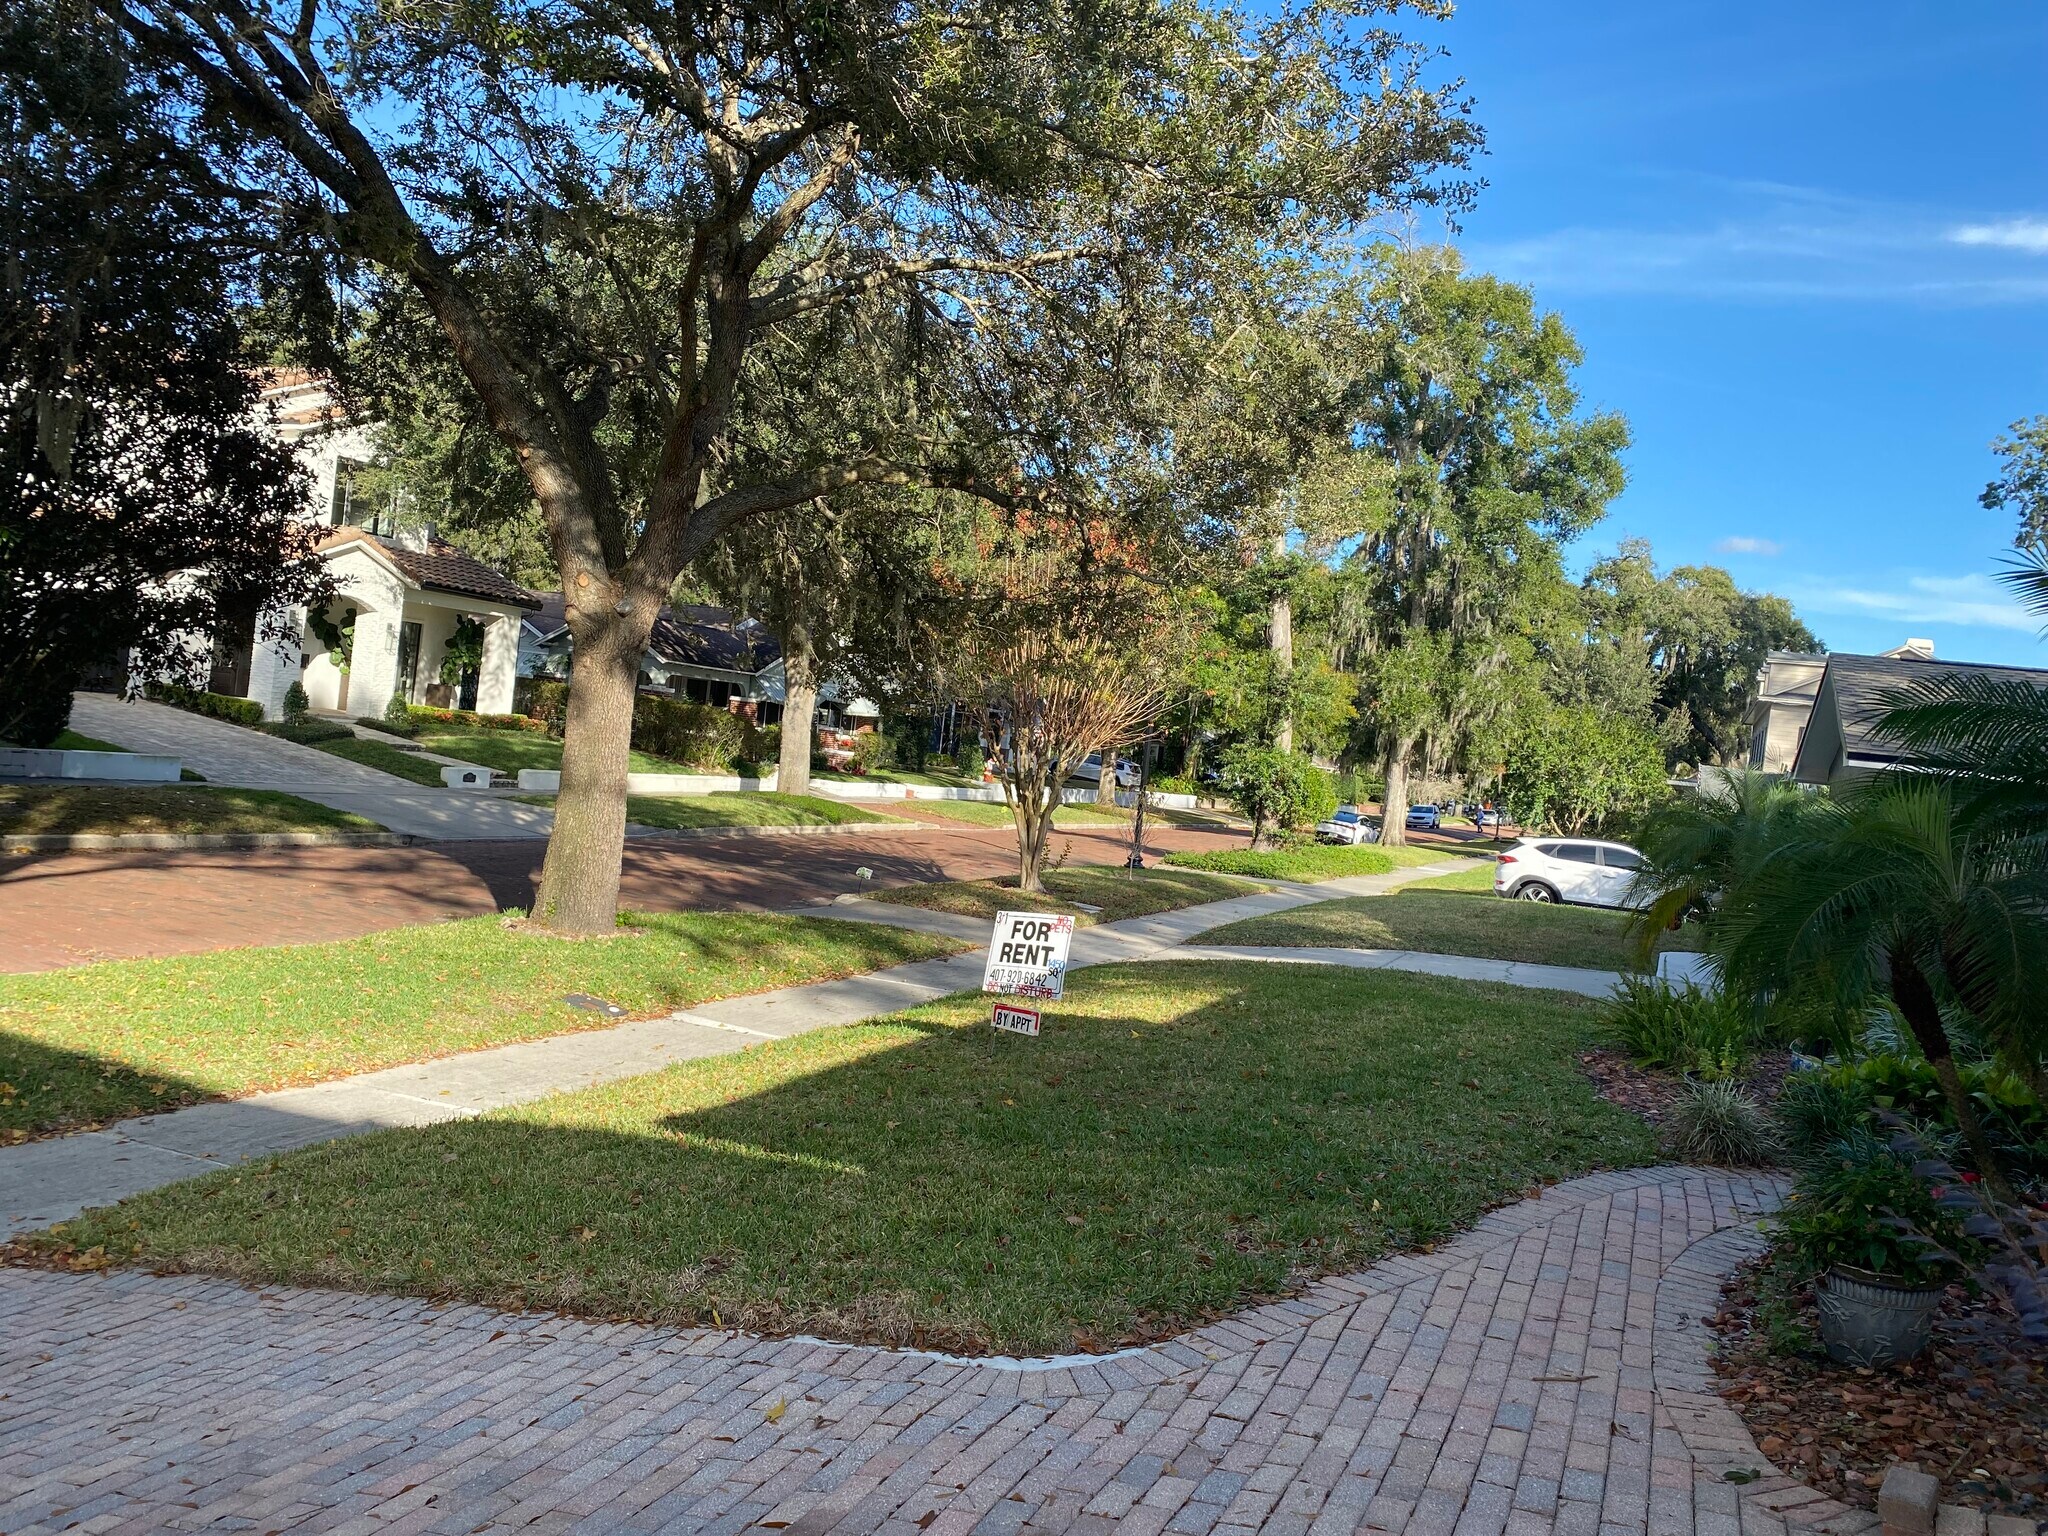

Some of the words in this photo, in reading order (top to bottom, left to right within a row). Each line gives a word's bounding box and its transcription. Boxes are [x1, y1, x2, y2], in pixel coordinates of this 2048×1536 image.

[1011, 920, 1050, 942] FOR
[1049, 924, 1072, 934] PETS
[999, 942, 1054, 967] RENT
[990, 969, 1047, 986] 407-920-6842
[988, 982, 998, 991] DO
[999, 984, 1013, 994] NOT
[1014, 984, 1053, 998] DISTURB
[996, 1011, 1008, 1026] BY
[1010, 1017, 1032, 1032] APPT
